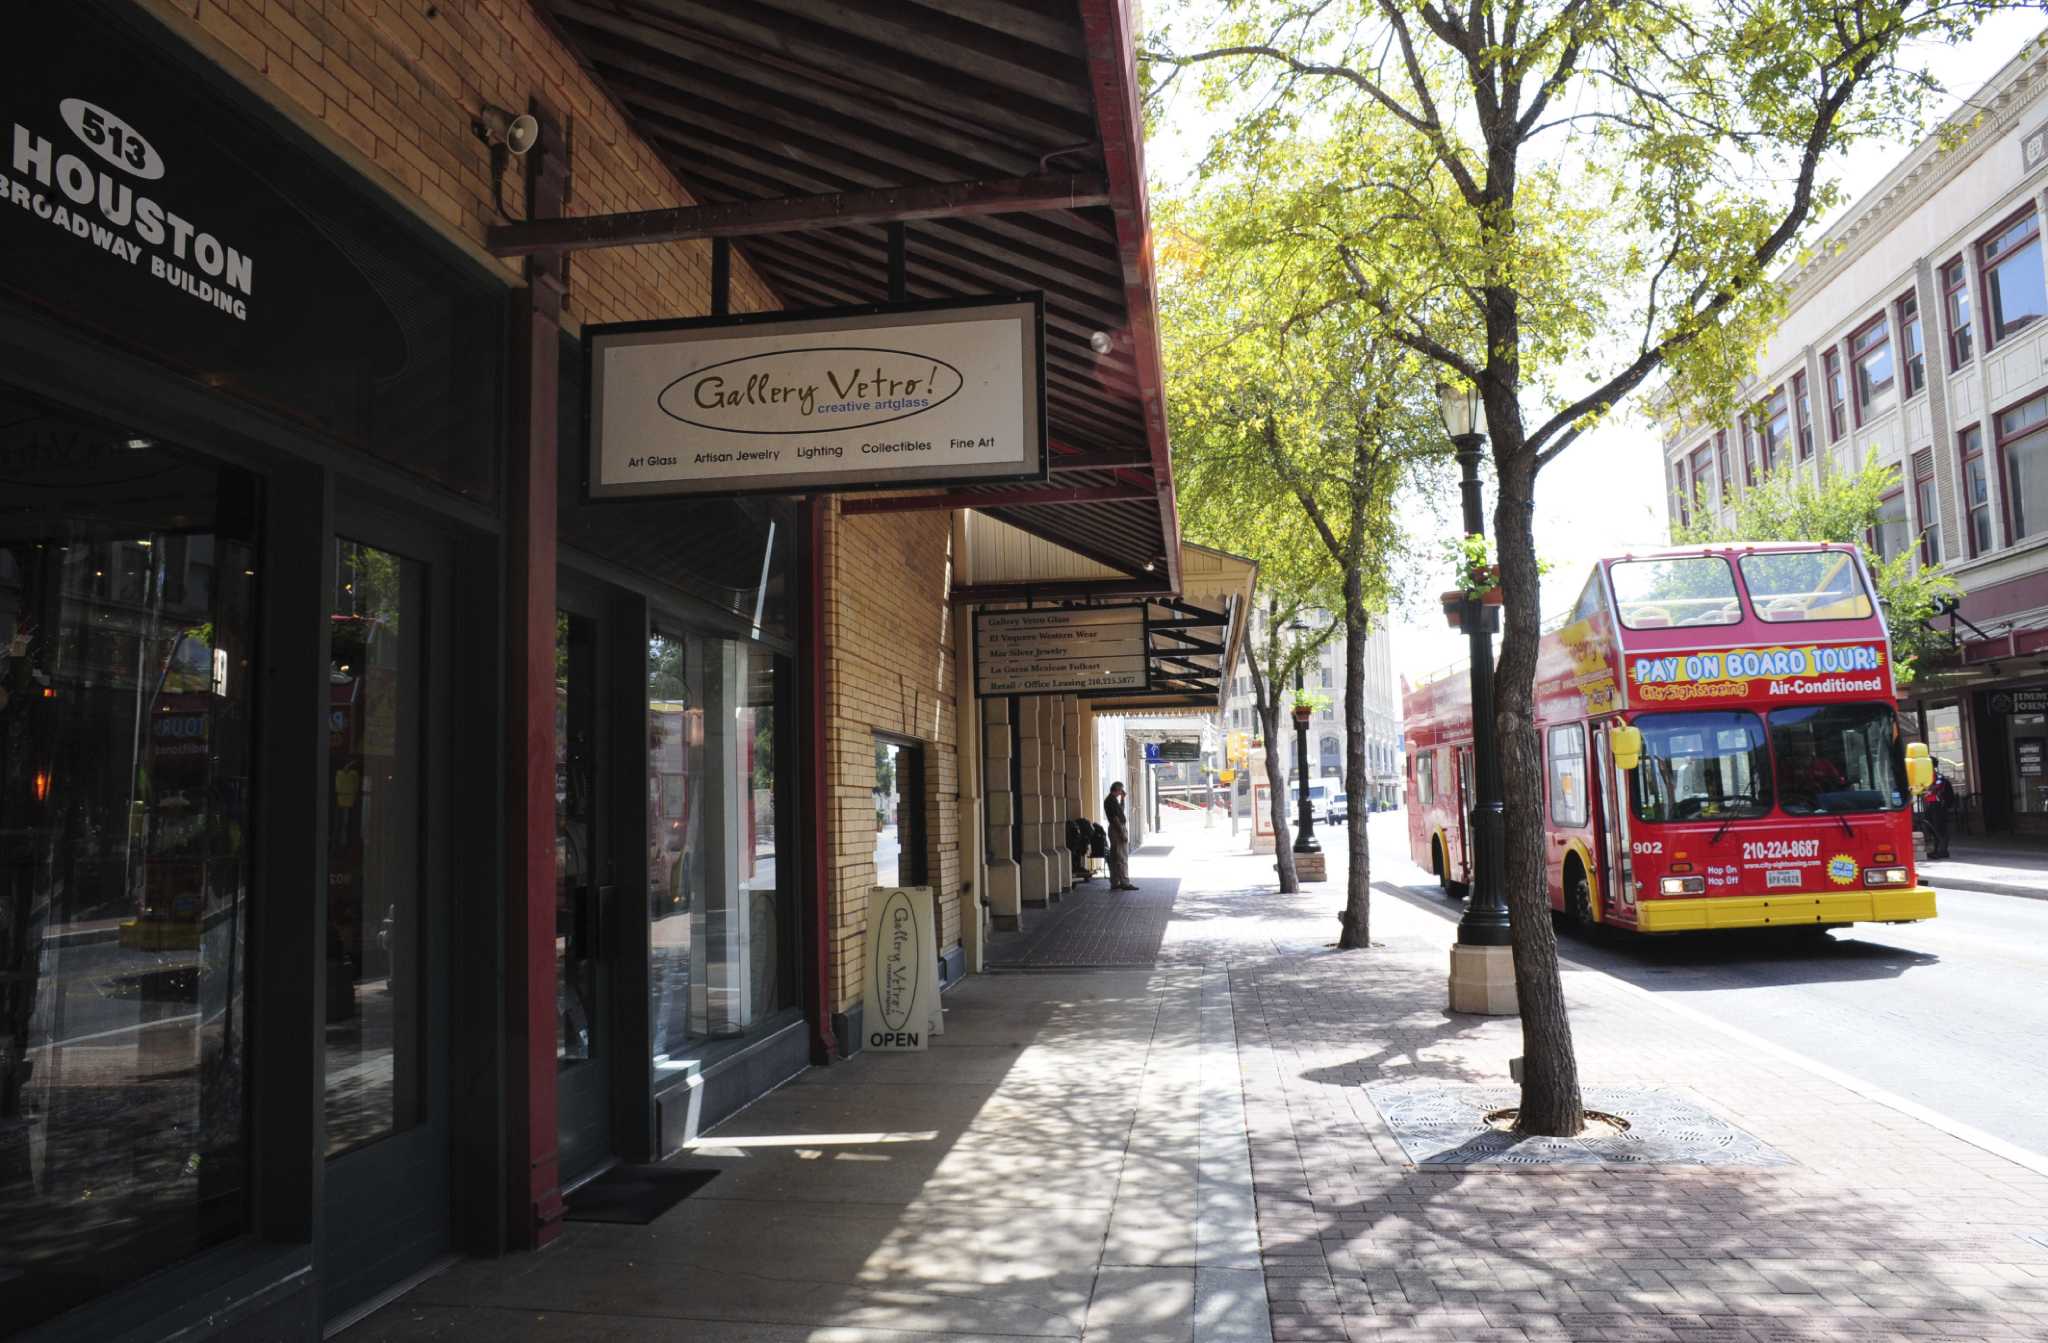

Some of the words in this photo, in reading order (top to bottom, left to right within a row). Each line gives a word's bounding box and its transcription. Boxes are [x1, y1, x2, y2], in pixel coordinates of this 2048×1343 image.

[81, 107, 146, 170] 513
[13, 122, 252, 296] HOUSTON
[0, 173, 143, 265] BROADWAY
[151, 255, 247, 321] BUILDING
[694, 373, 819, 416] Gallery
[826, 366, 938, 400] Vetro!
[817, 400, 870, 414] creative
[875, 397, 929, 411] artglass
[628, 457, 644, 468] Art
[647, 456, 678, 467] Glass
[694, 453, 733, 464] Artisan
[736, 449, 780, 462] Jewelry
[797, 445, 843, 459] Lighting
[861, 440, 932, 454] Collectibles
[950, 438, 975, 448] Fine
[978, 437, 995, 447] Art
[1076, 629, 1098, 638] Wear
[1636, 656, 1679, 684] PAY
[1686, 655, 1720, 680] ON
[1726, 649, 1806, 678] BOARD
[1812, 646, 1878, 672] TOUR!
[1024, 680, 1050, 689] Office
[1052, 679, 1086, 689] Leasing
[1769, 676, 1882, 695] Air-Conditioned
[1633, 841, 1663, 855] 902
[1743, 840, 1820, 859] 210-224-8687
[1708, 866, 1724, 875] Hop
[1726, 865, 1737, 873] On
[1708, 877, 1724, 886] Hop
[1726, 876, 1738, 884] Off
[888, 908, 908, 961] Gallery
[870, 1033, 919, 1047] OPEN
